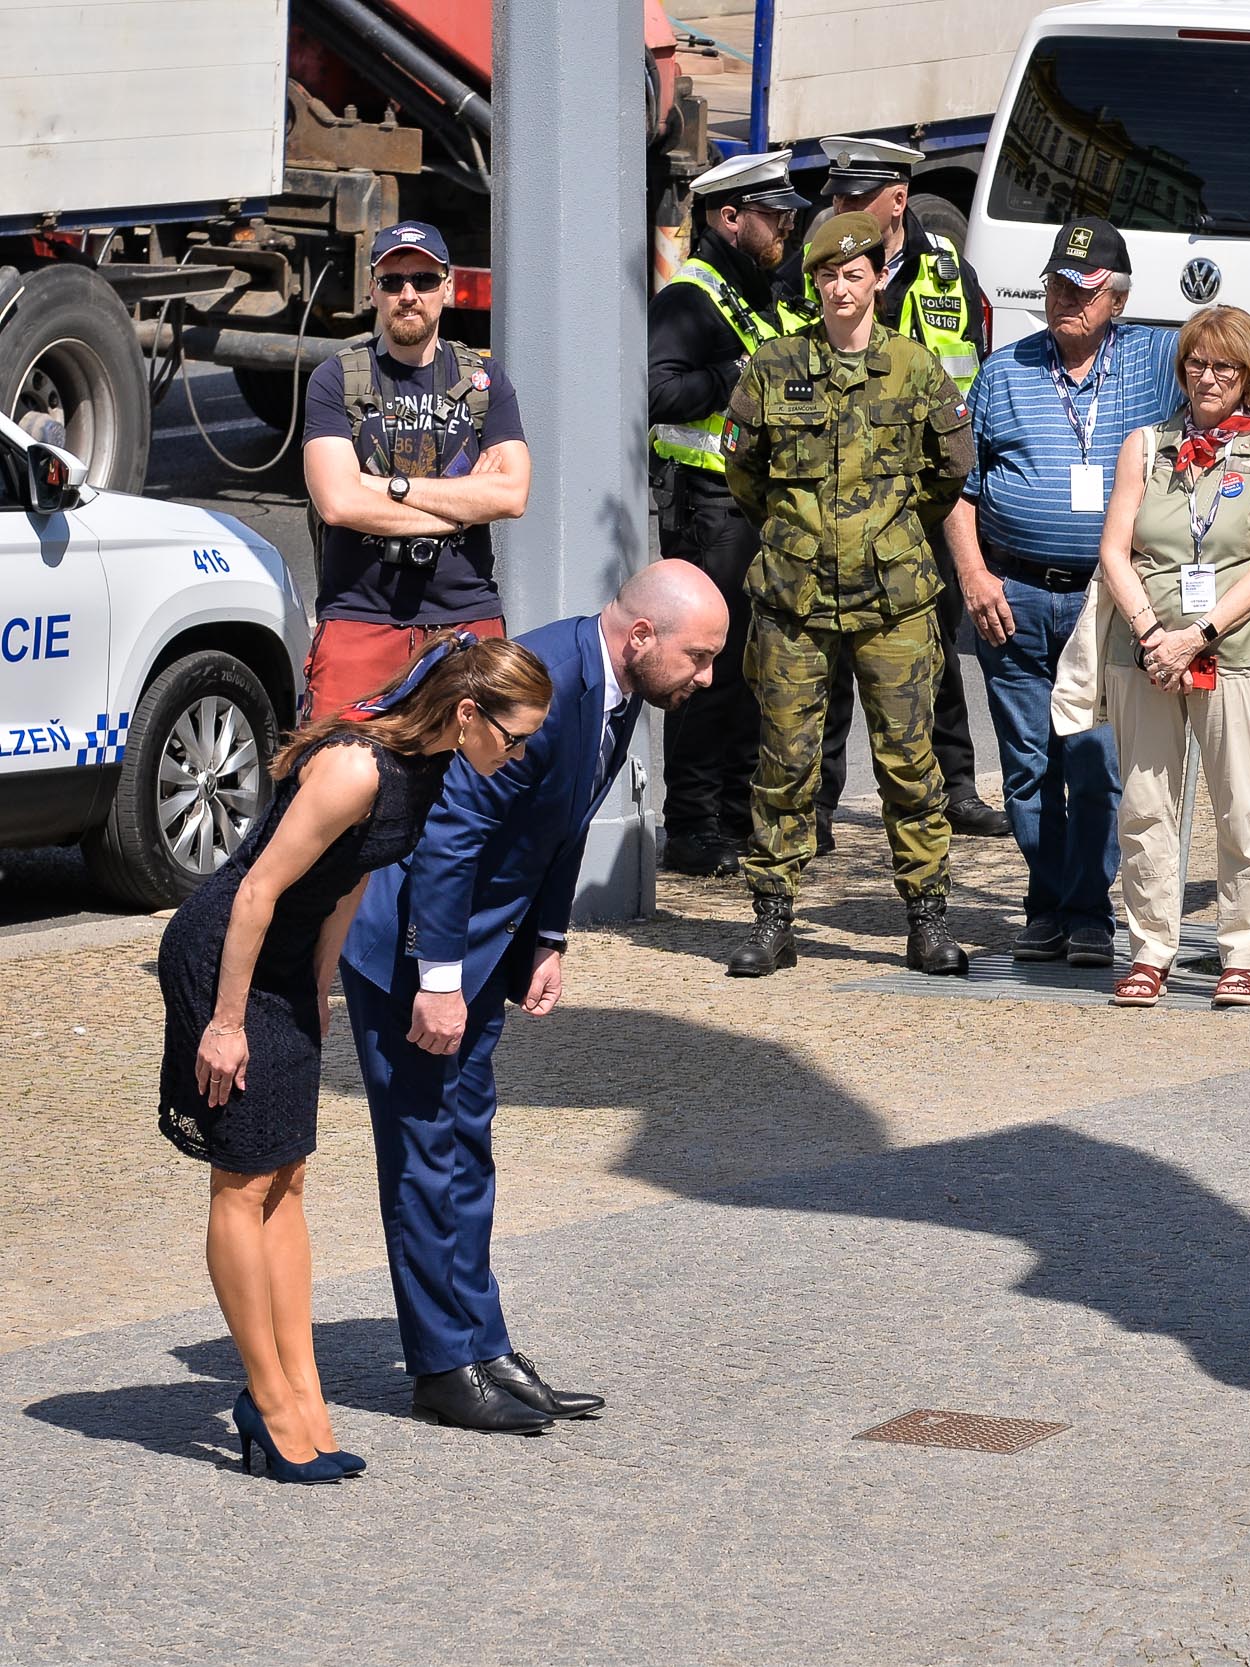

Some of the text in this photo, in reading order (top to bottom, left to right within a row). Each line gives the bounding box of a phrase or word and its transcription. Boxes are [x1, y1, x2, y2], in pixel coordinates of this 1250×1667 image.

[921, 298, 961, 309] POLICIE
[193, 549, 230, 574] 416
[1, 614, 71, 663] CIE
